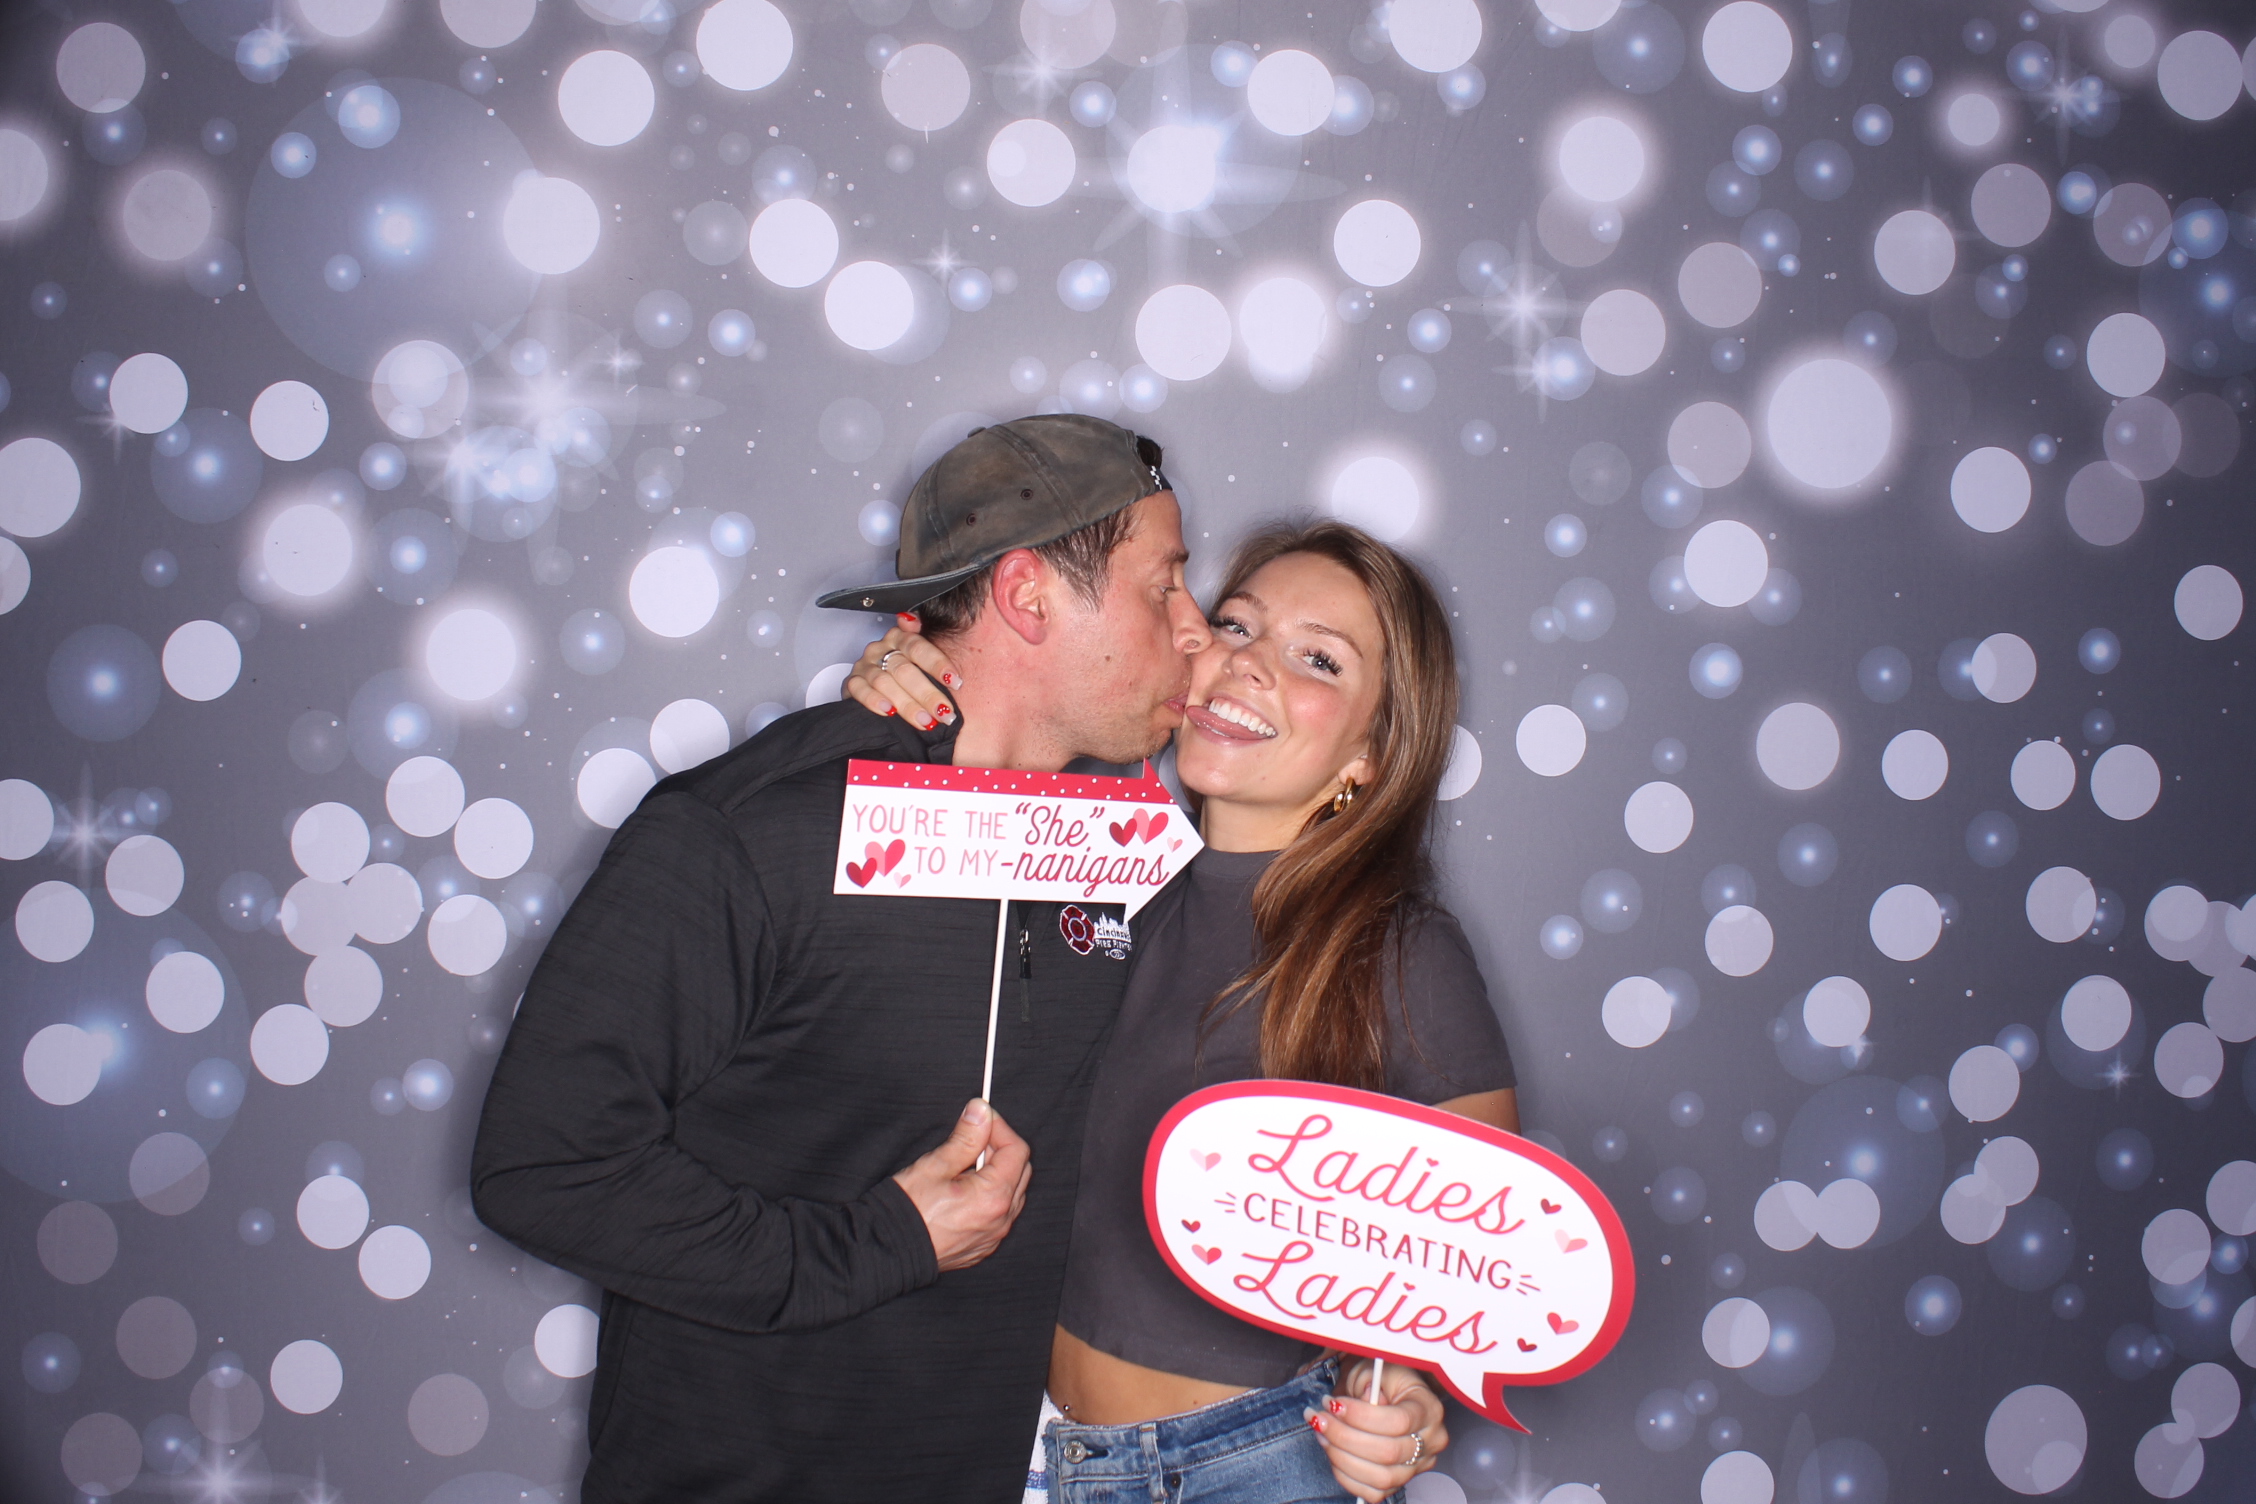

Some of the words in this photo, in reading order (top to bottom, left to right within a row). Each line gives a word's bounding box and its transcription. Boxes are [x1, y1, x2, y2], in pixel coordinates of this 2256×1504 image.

[853, 804, 949, 837] YOU'RE
[964, 810, 1008, 840] THE
[913, 846, 946, 875] TO
[1248, 1114, 1525, 1235] Ladies
[1243, 1193, 1513, 1291] CELEBRATING
[1233, 1240, 1498, 1355] Ladies
